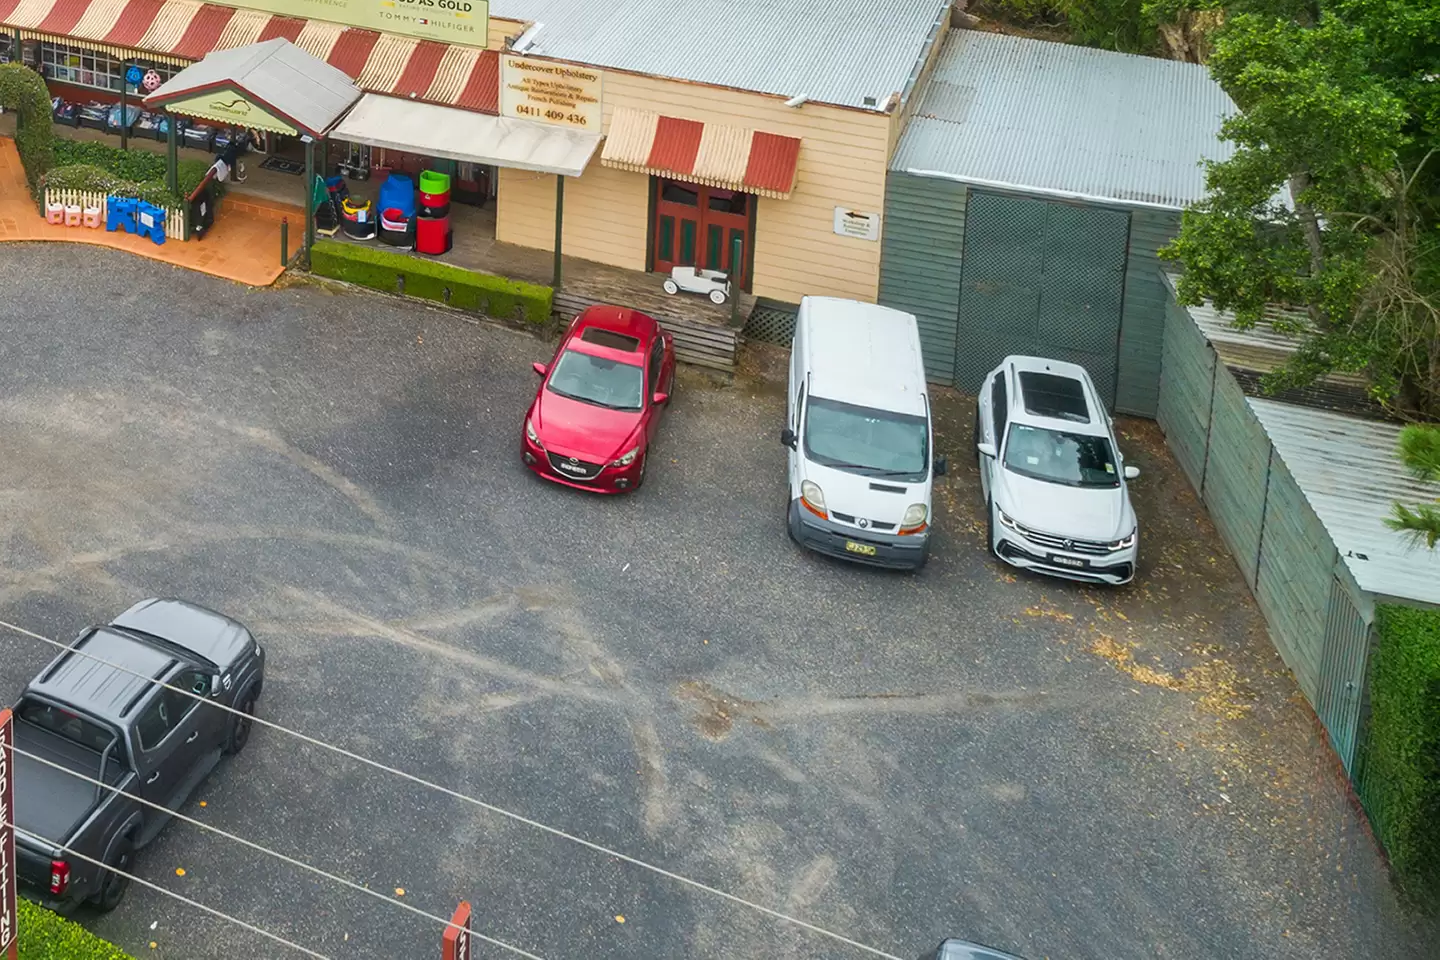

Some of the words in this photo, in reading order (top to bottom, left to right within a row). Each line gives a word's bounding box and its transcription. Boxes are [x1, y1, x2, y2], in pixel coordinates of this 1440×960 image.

[438, 0, 472, 12] GOLD
[379, 11, 417, 22] TOMMY
[431, 20, 475, 33] HILFIGER
[508, 60, 553, 74] Undercover
[555, 67, 598, 83] Upholstery
[516, 104, 540, 117] 0411
[544, 109, 564, 121] 409
[566, 113, 587, 126] 436
[0, 831, 10, 946] FITTING
